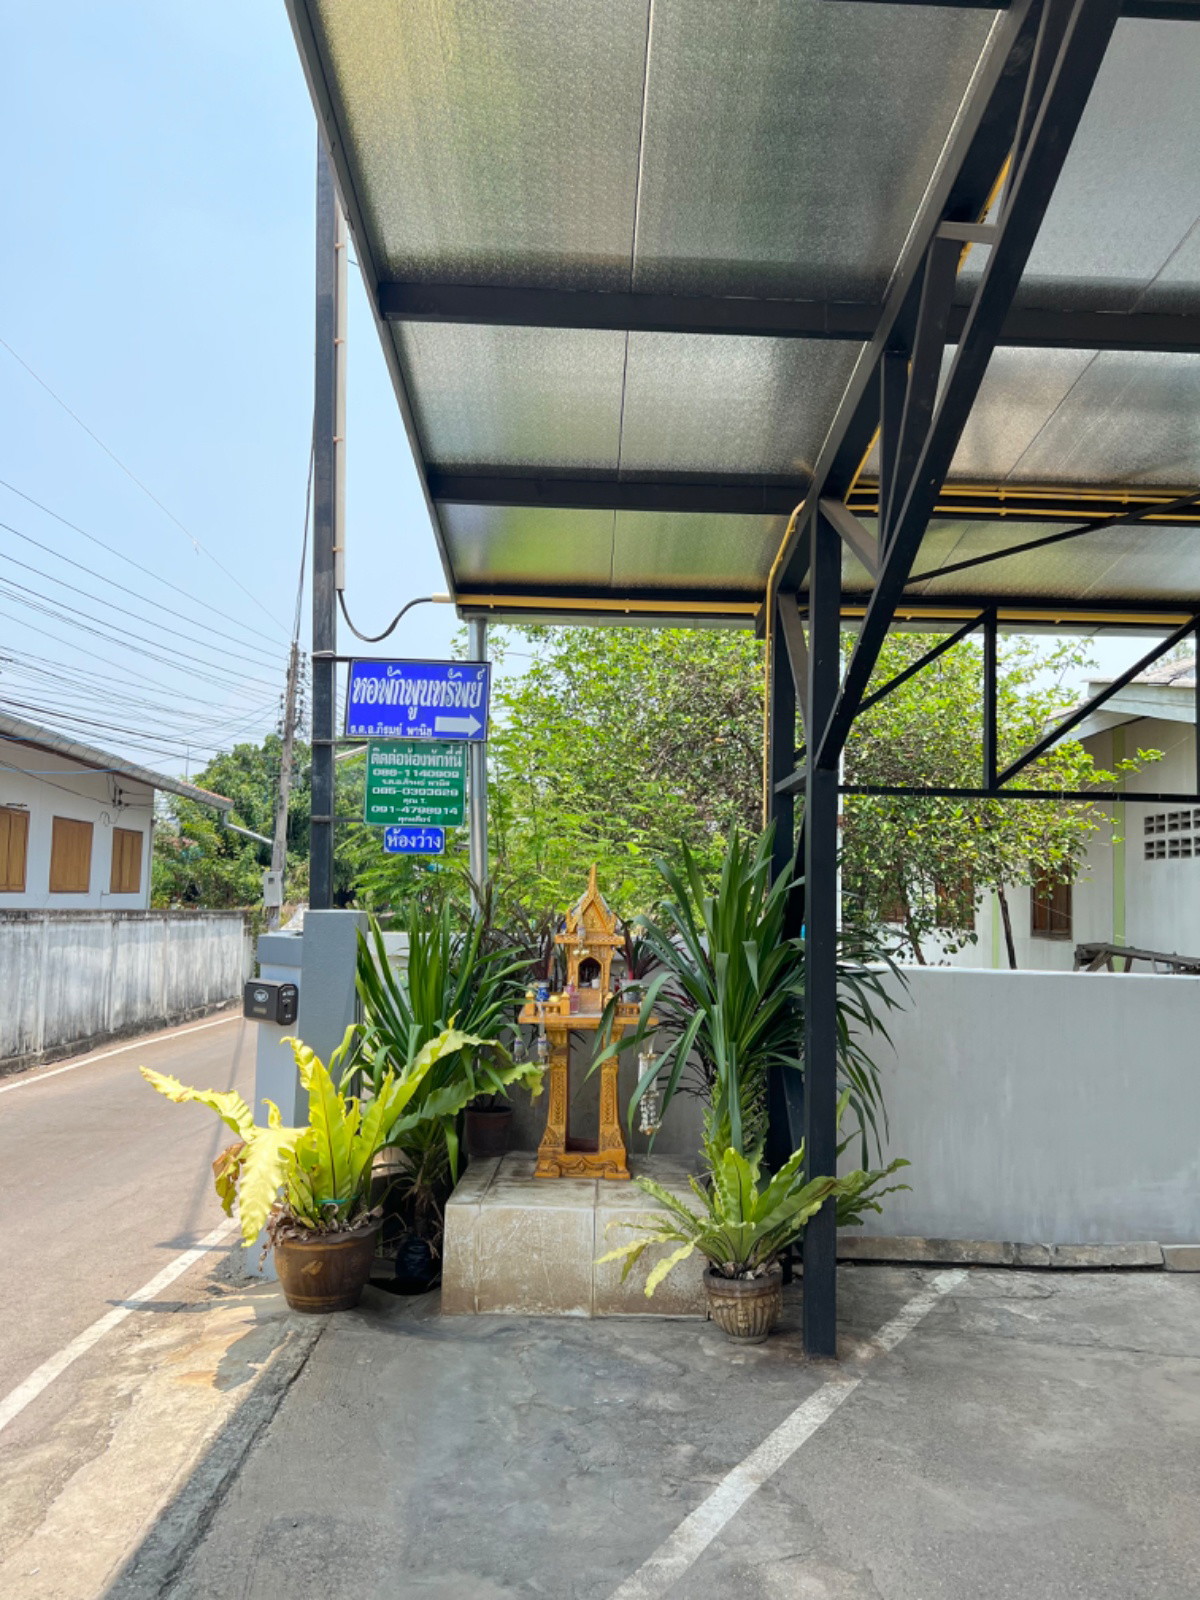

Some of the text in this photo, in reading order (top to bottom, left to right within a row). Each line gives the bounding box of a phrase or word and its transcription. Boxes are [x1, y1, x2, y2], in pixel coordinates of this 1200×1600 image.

[352, 665, 486, 721] หอพักพูนทรัพย์
[371, 745, 463, 768] ติดต่อห้องพักที่นี่
[386, 828, 441, 849] ห้องว่าง
